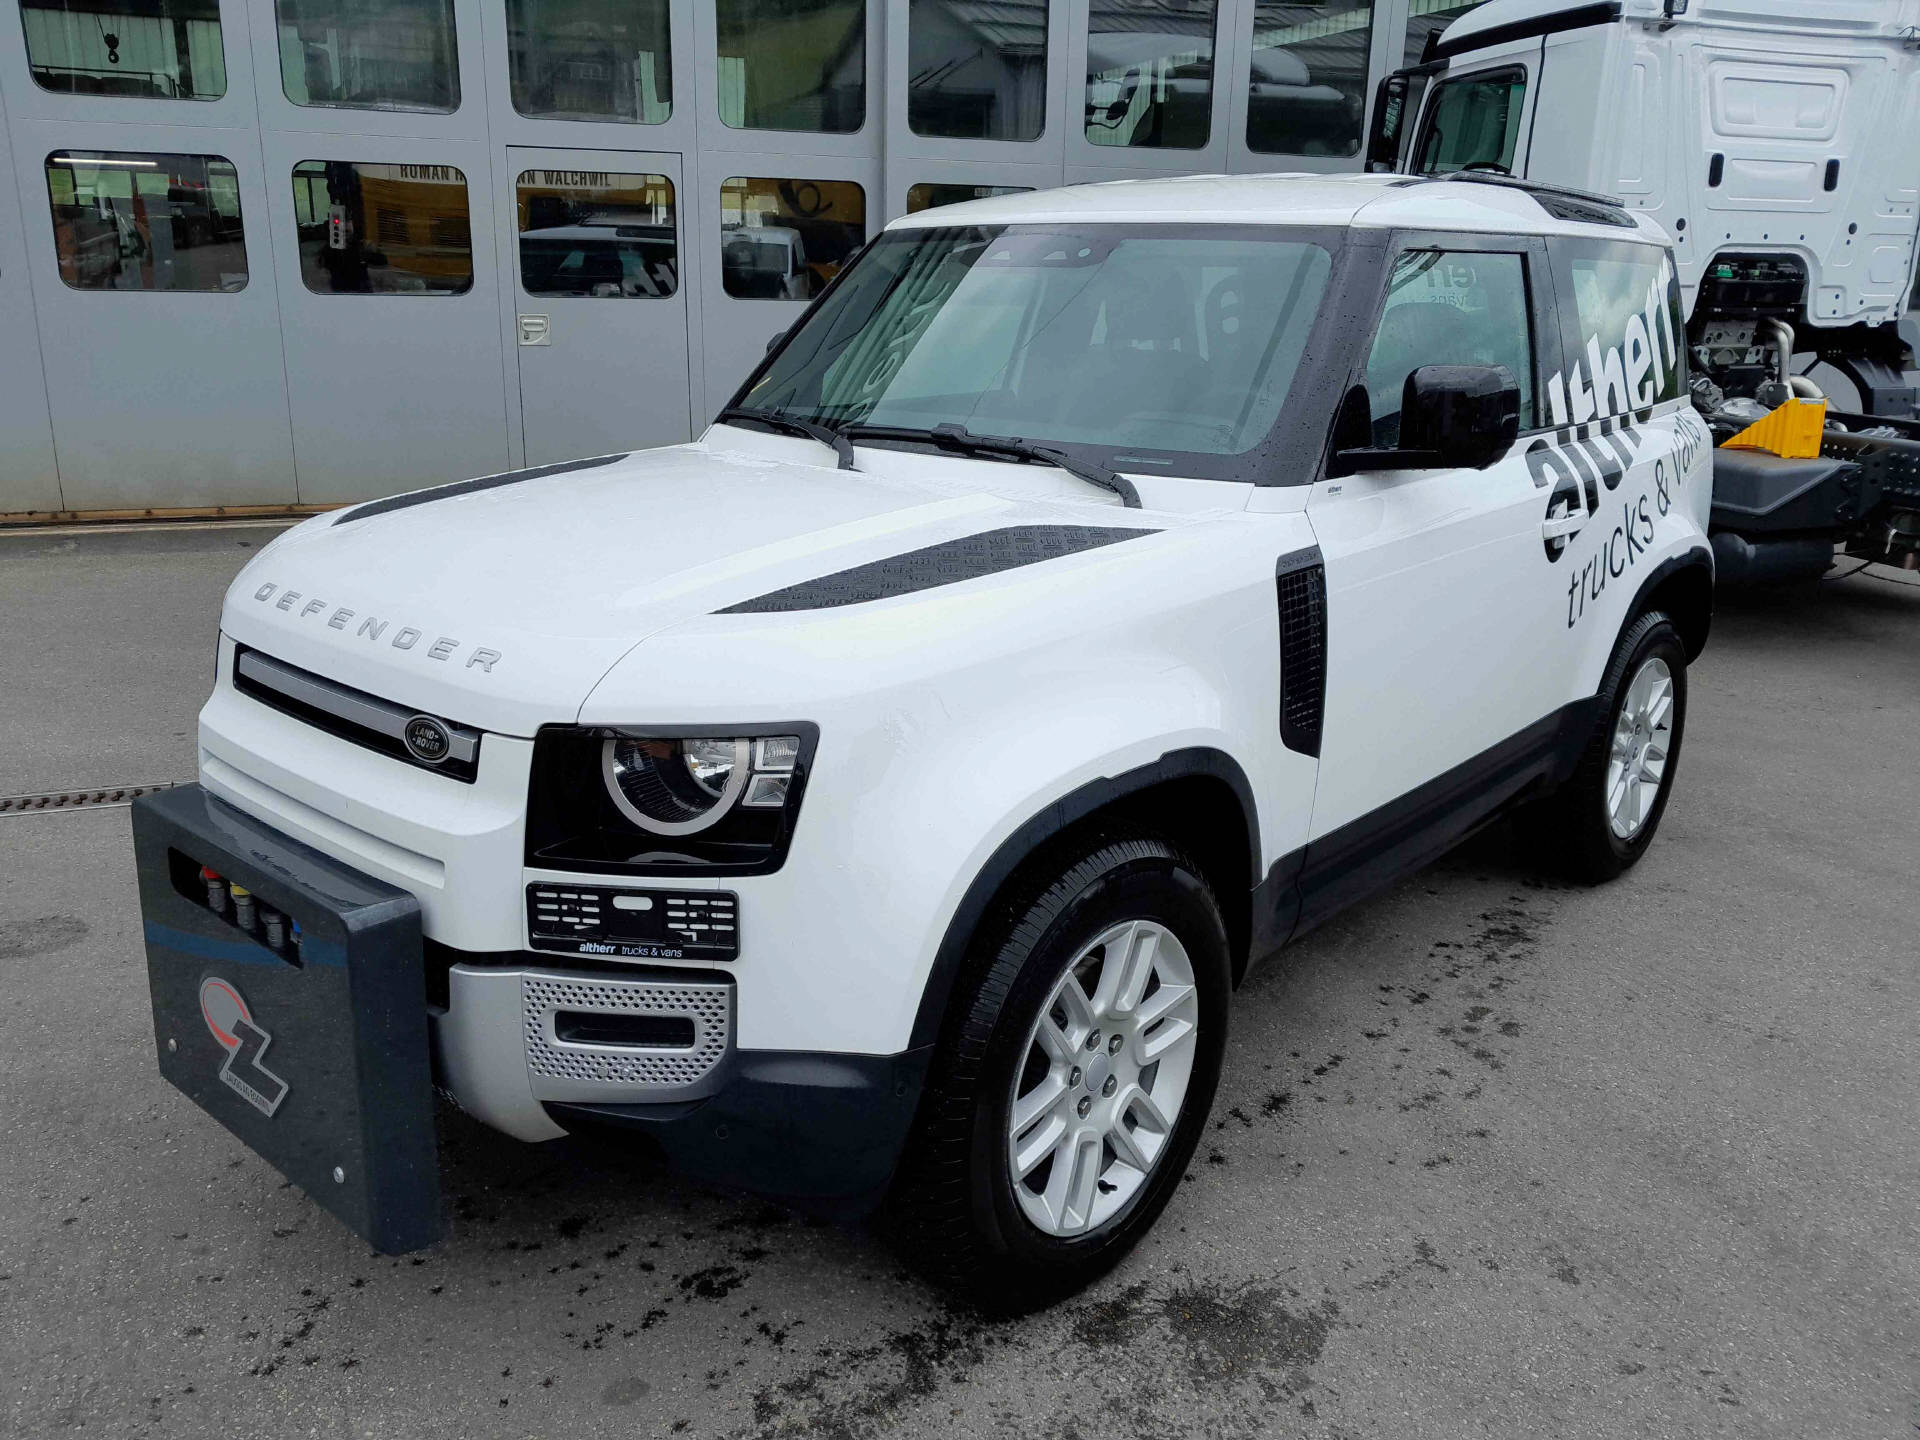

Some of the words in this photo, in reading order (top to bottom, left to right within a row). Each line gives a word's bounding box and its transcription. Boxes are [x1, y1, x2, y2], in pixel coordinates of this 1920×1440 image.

[544, 170, 612, 187] WALCHWIL
[1525, 255, 1676, 563] altherr
[1567, 494, 1655, 629] trucks
[1655, 458, 1671, 517] &
[254, 582, 502, 673] DEFENDER
[579, 942, 616, 954] altherr
[621, 945, 649, 956] trucks
[650, 948, 658, 956] &
[660, 948, 682, 958] vans
